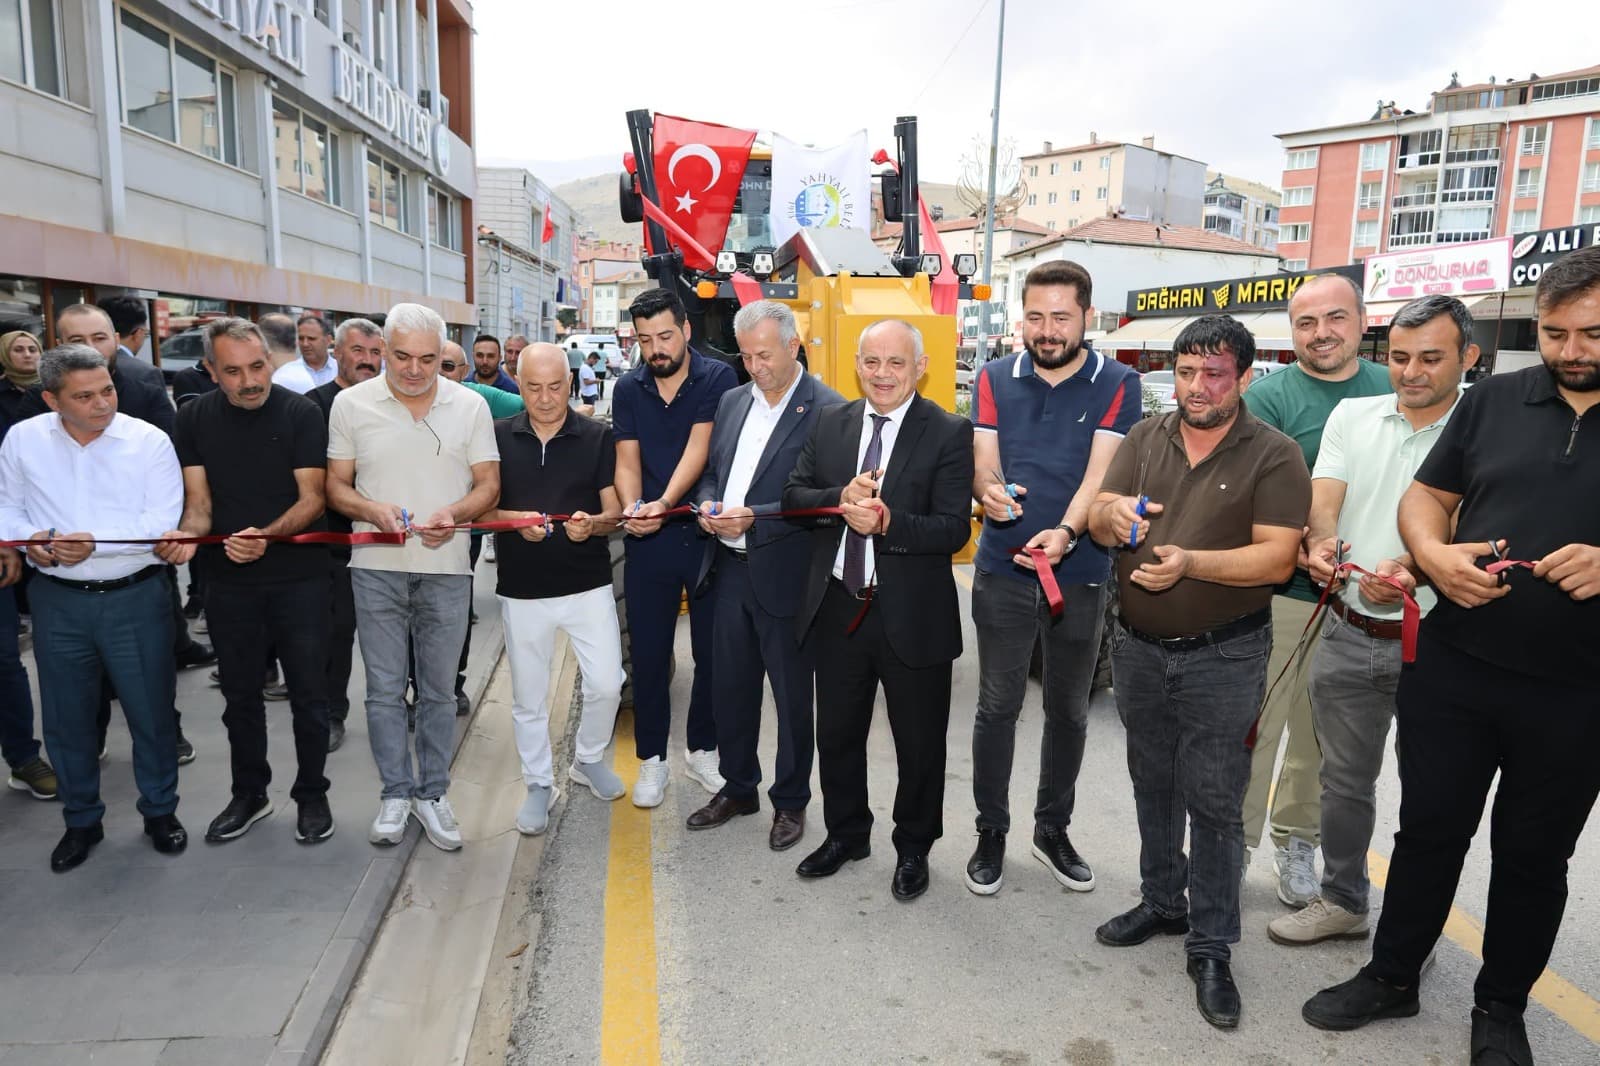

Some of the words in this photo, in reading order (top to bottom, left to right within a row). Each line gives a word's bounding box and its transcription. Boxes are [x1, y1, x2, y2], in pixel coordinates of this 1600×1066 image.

[738, 180, 763, 190] OHN
[1394, 259, 1489, 284] DONDURMA
[1512, 262, 1554, 286] ÇO
[1136, 286, 1205, 312] DAĞHAN
[1236, 273, 1336, 305] MARK
